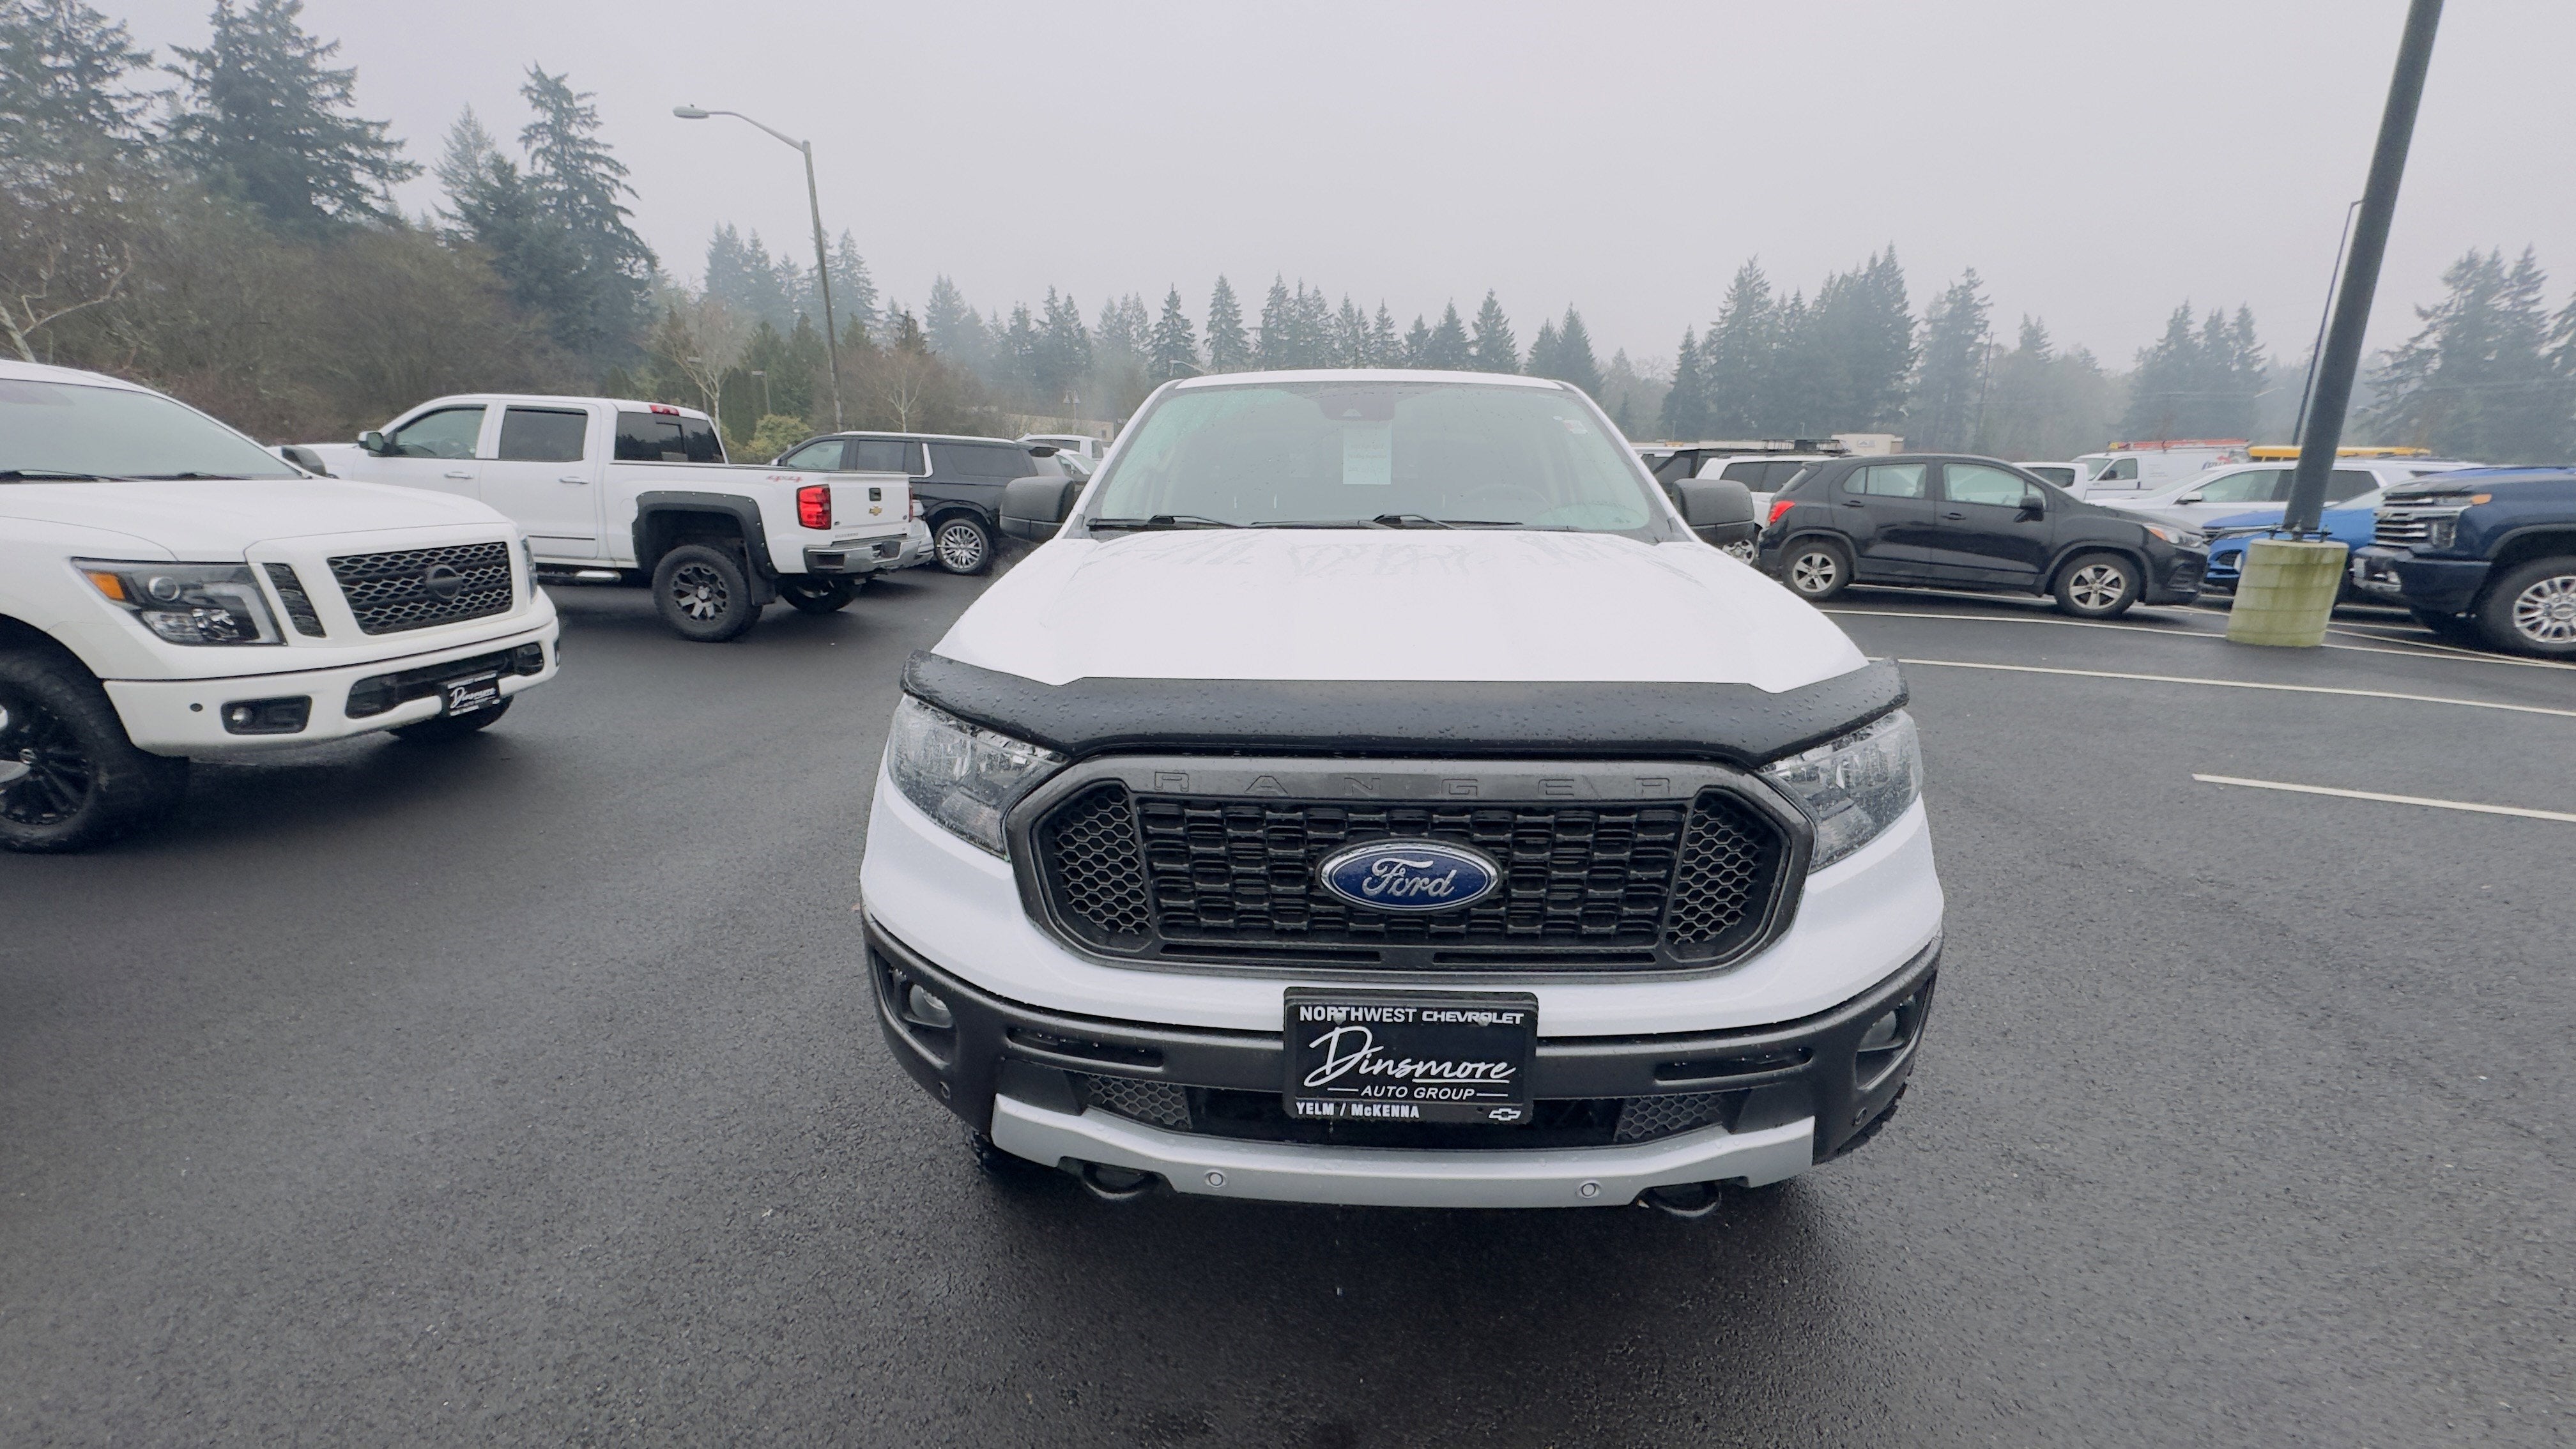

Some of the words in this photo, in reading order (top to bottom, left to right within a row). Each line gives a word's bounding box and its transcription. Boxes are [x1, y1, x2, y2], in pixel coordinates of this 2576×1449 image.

[1154, 771, 1671, 797] RANGER
[1362, 857, 1457, 898] Ford
[1300, 1006, 1417, 1023] NORTHWEST
[1422, 1010, 1524, 1025] CHEVROLET
[1303, 1025, 1516, 1087] Dinsmore
[1361, 1085, 1408, 1098] AUTO
[1414, 1087, 1475, 1100] GROUP
[1296, 1102, 1335, 1116] YELM
[1351, 1103, 1420, 1118] McKENNA
